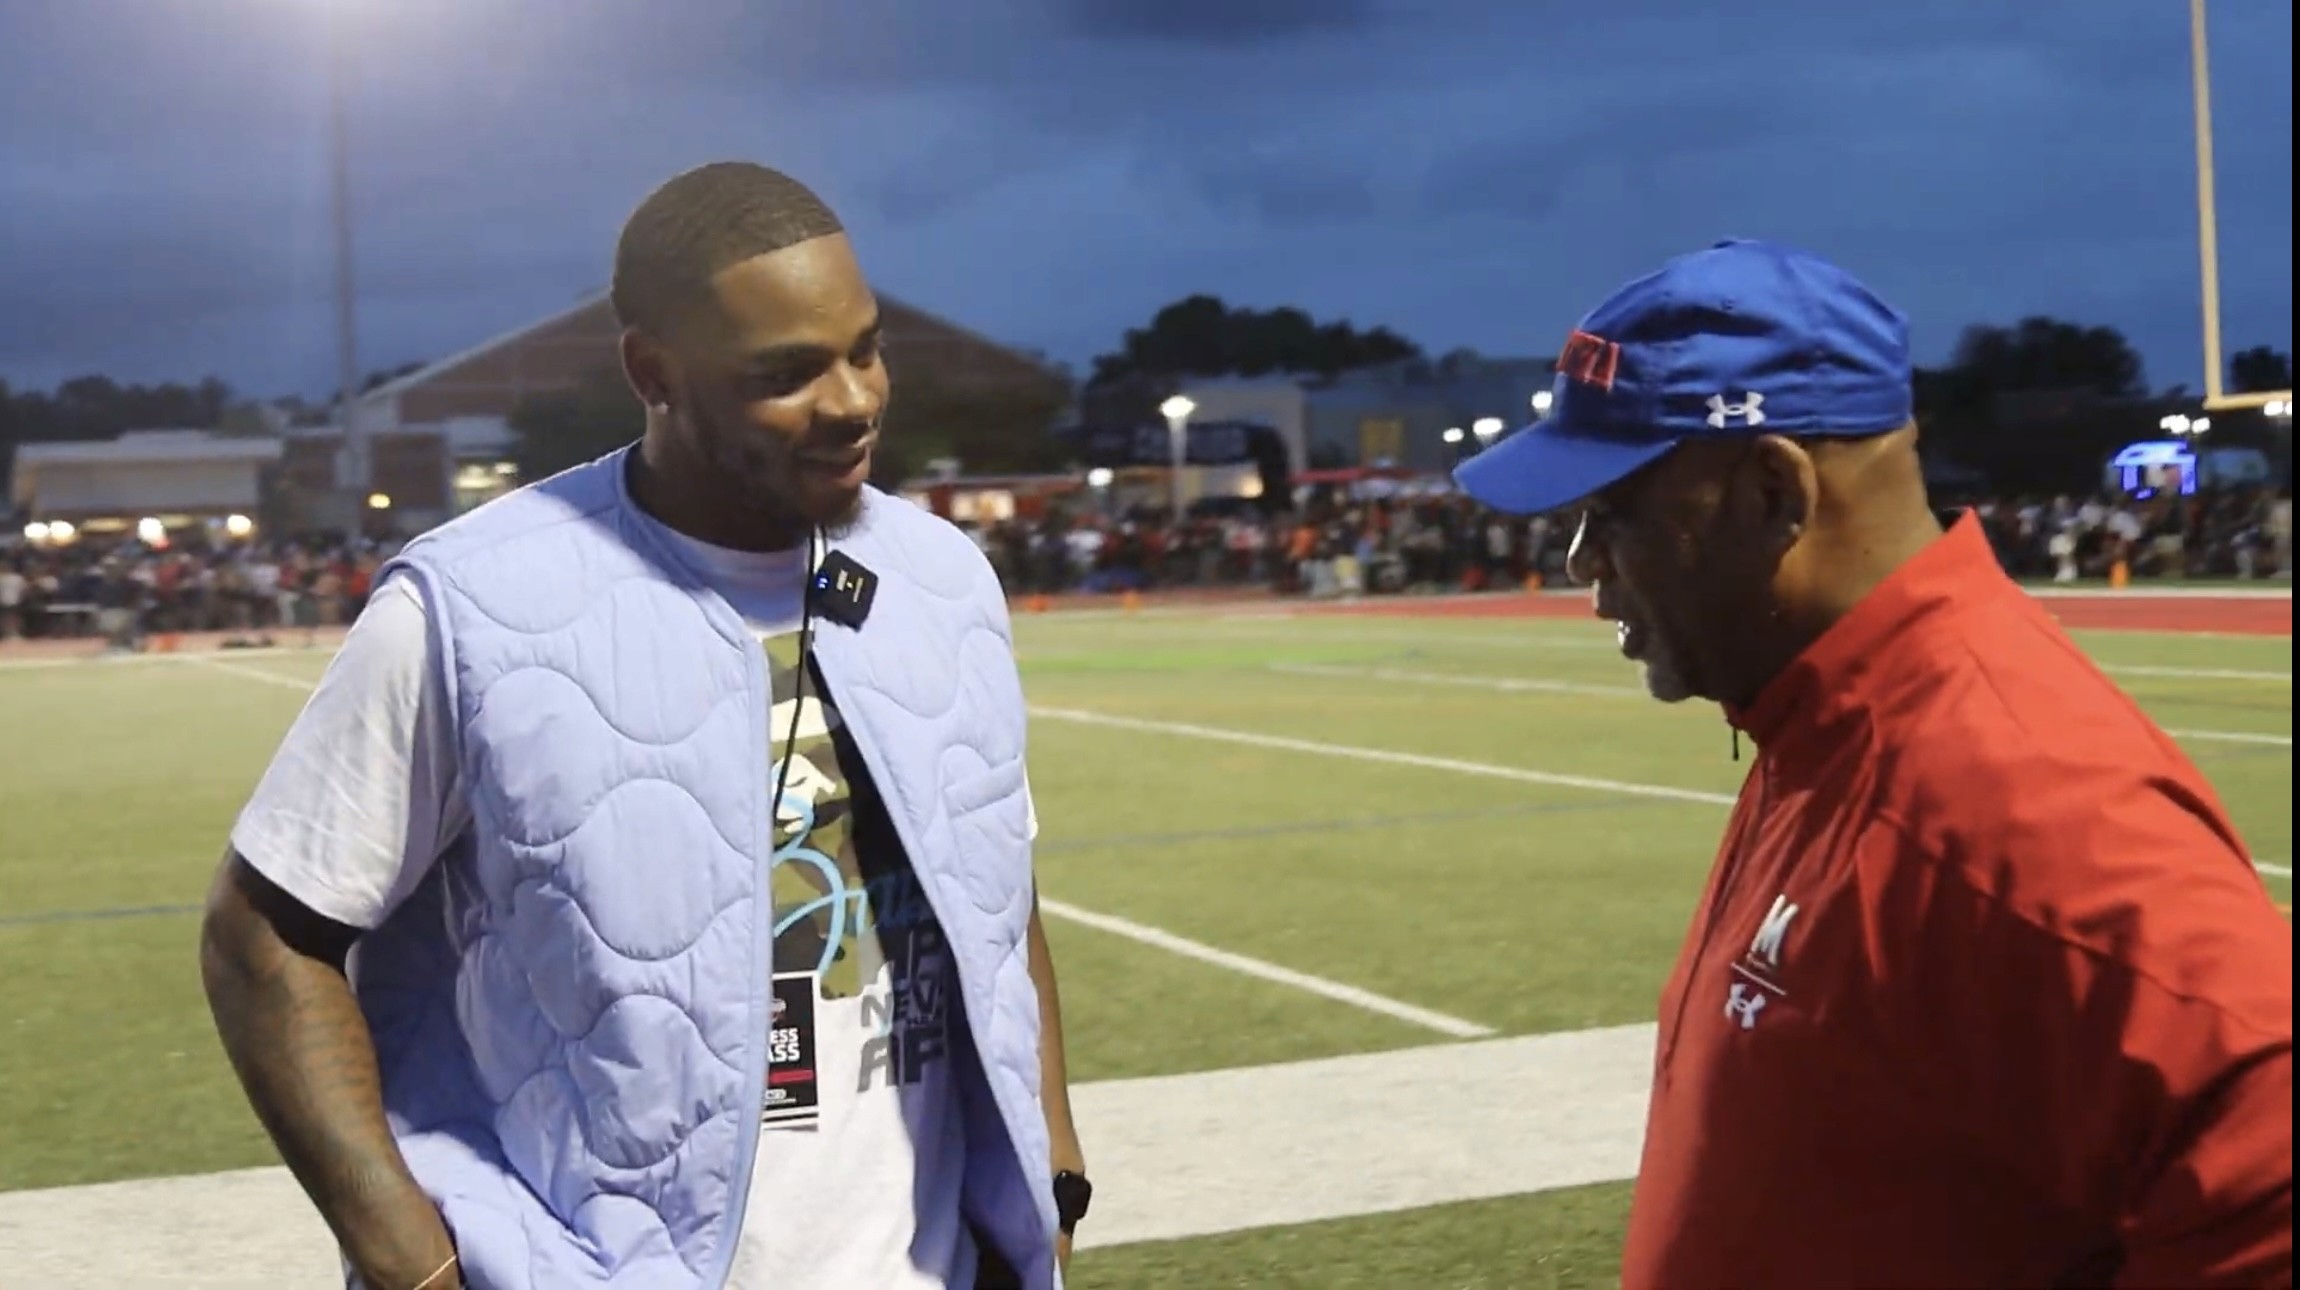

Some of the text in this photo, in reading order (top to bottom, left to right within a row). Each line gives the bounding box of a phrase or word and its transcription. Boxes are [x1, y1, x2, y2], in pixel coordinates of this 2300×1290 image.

[860, 974, 945, 1028] NEV
[769, 1027, 799, 1044] ESS
[767, 1042, 800, 1063] ASS
